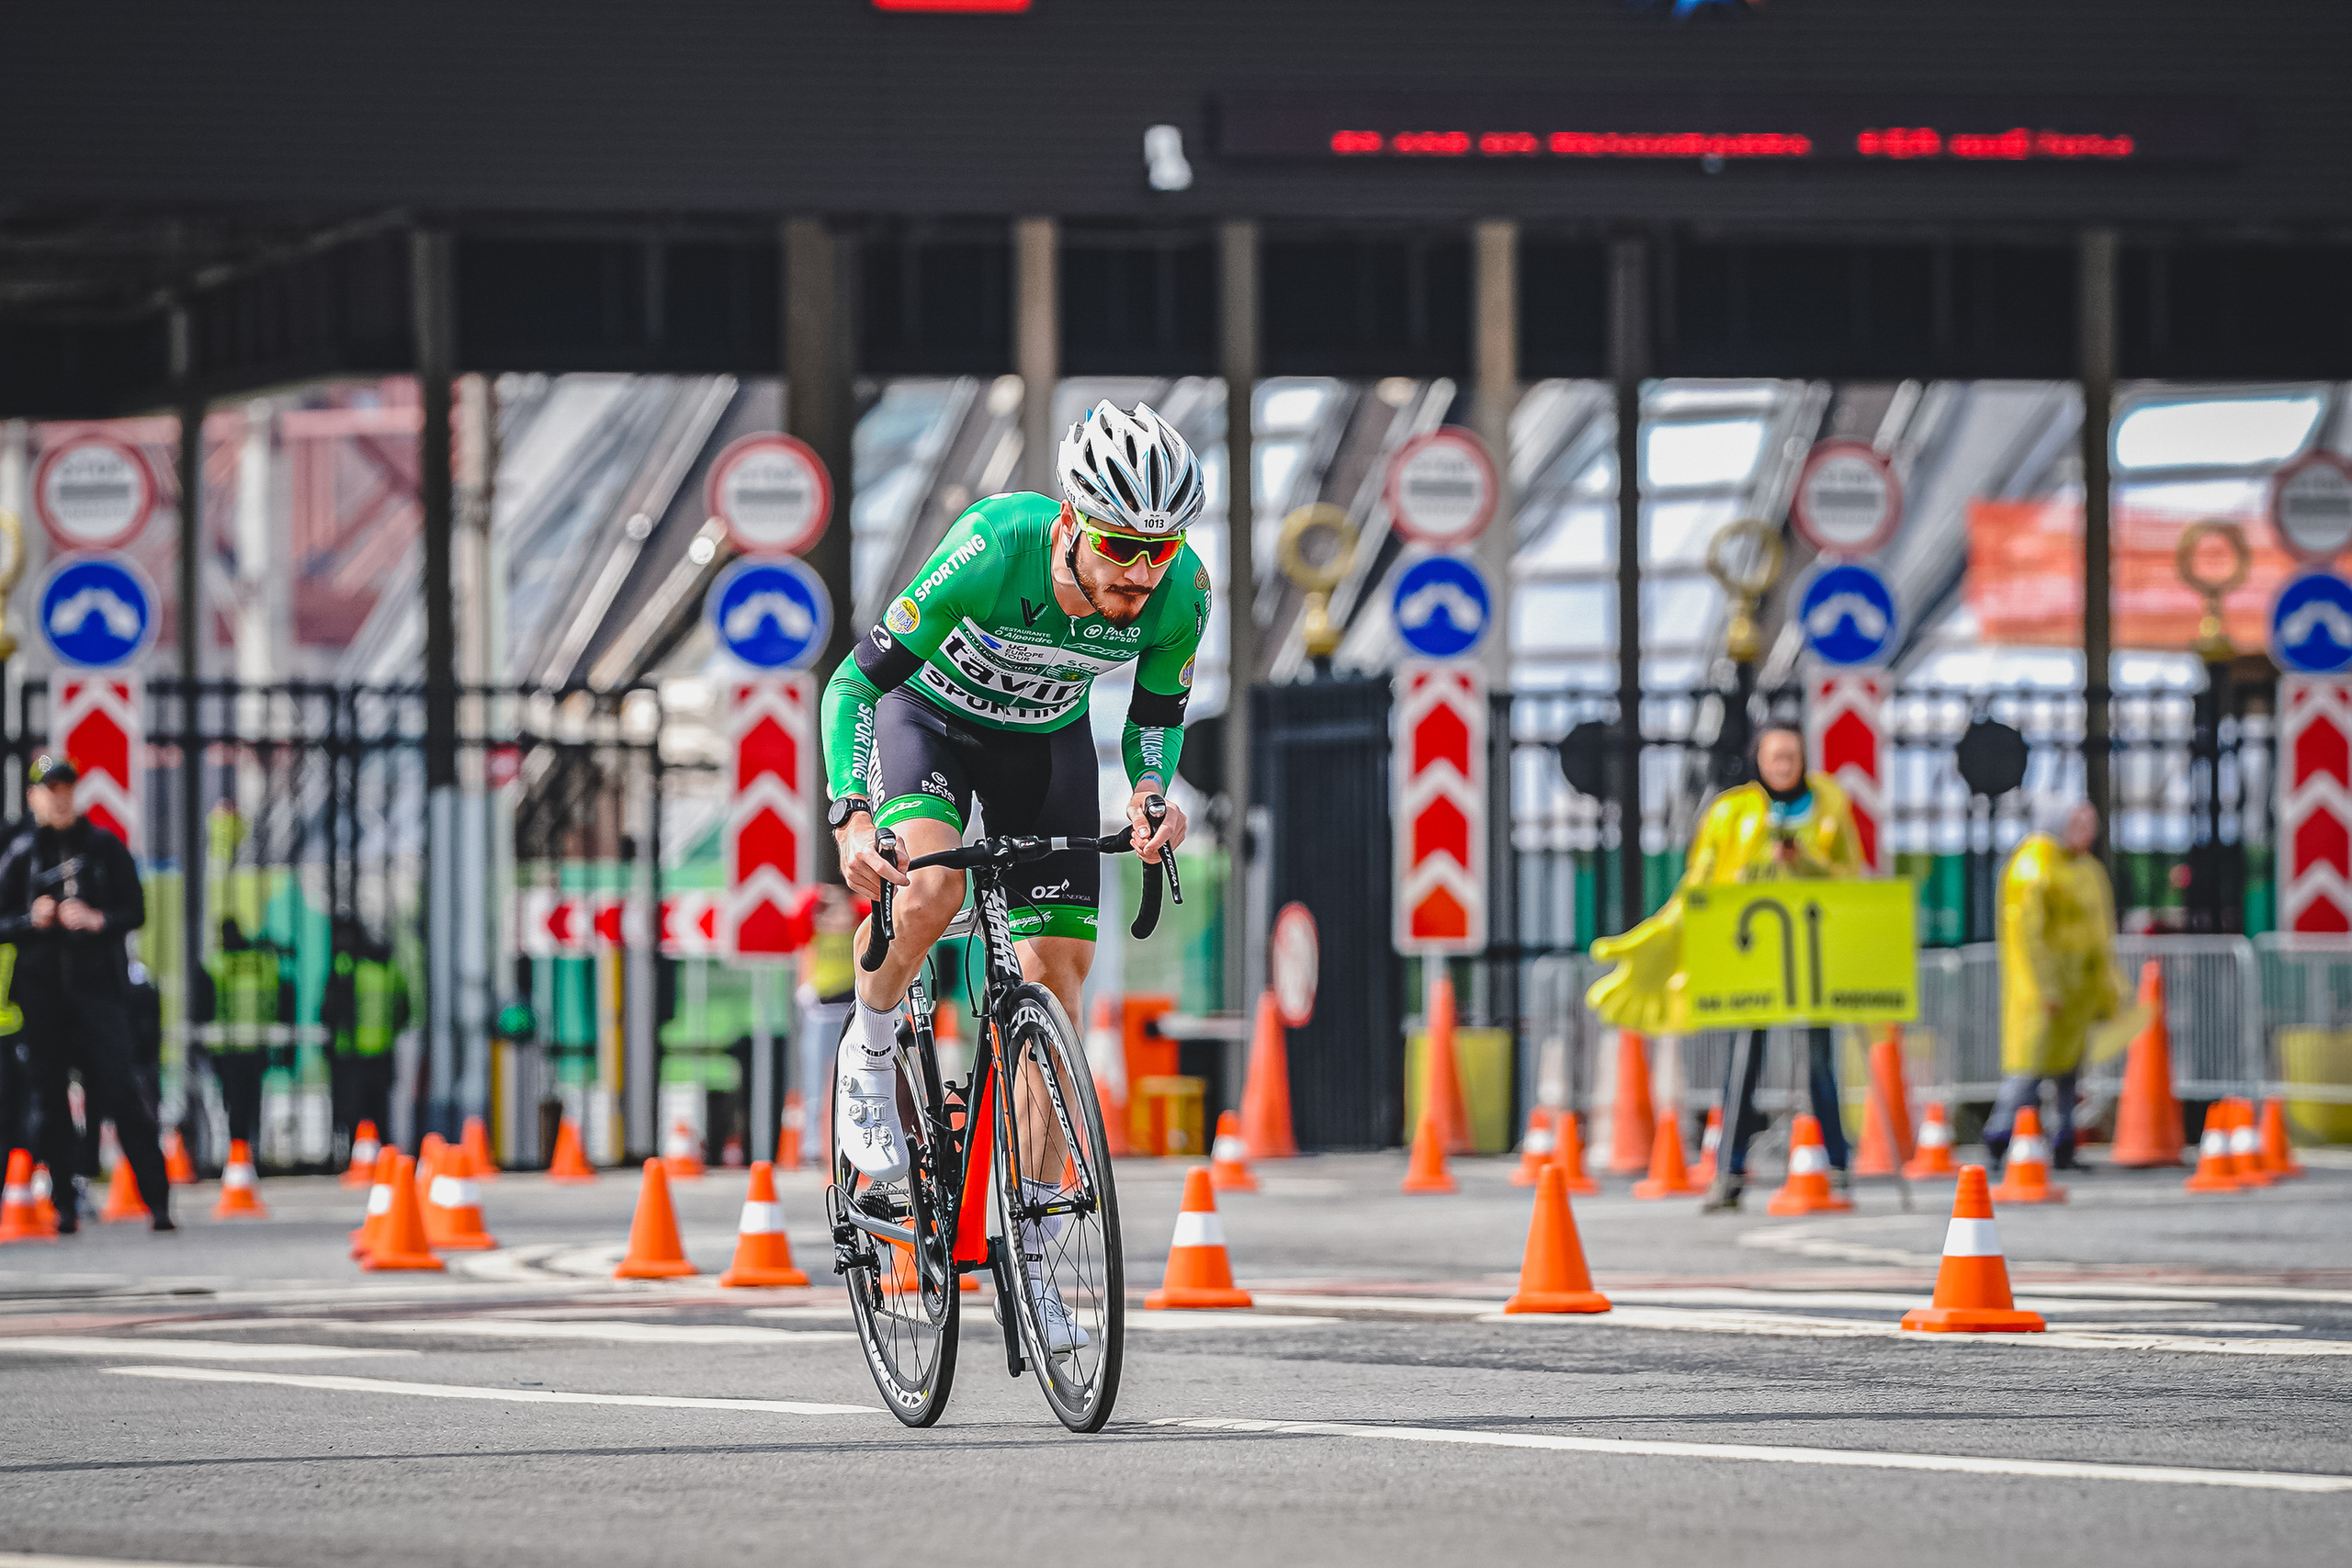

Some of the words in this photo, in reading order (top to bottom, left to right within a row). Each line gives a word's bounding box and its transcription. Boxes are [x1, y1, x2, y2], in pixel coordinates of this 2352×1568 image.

[1143, 518, 1165, 529] 1013
[914, 534, 986, 602] SPORTING
[1000, 626, 1051, 637] RESTAURANTE
[1008, 643, 1028, 652] UCI
[1003, 652, 1030, 661] TOUR
[1004, 649, 1045, 659] EUROPE
[944, 635, 1084, 702] tavir
[1067, 660, 1100, 671] SCP
[852, 703, 873, 780] SPORTING
[1031, 886, 1061, 899] OZ
